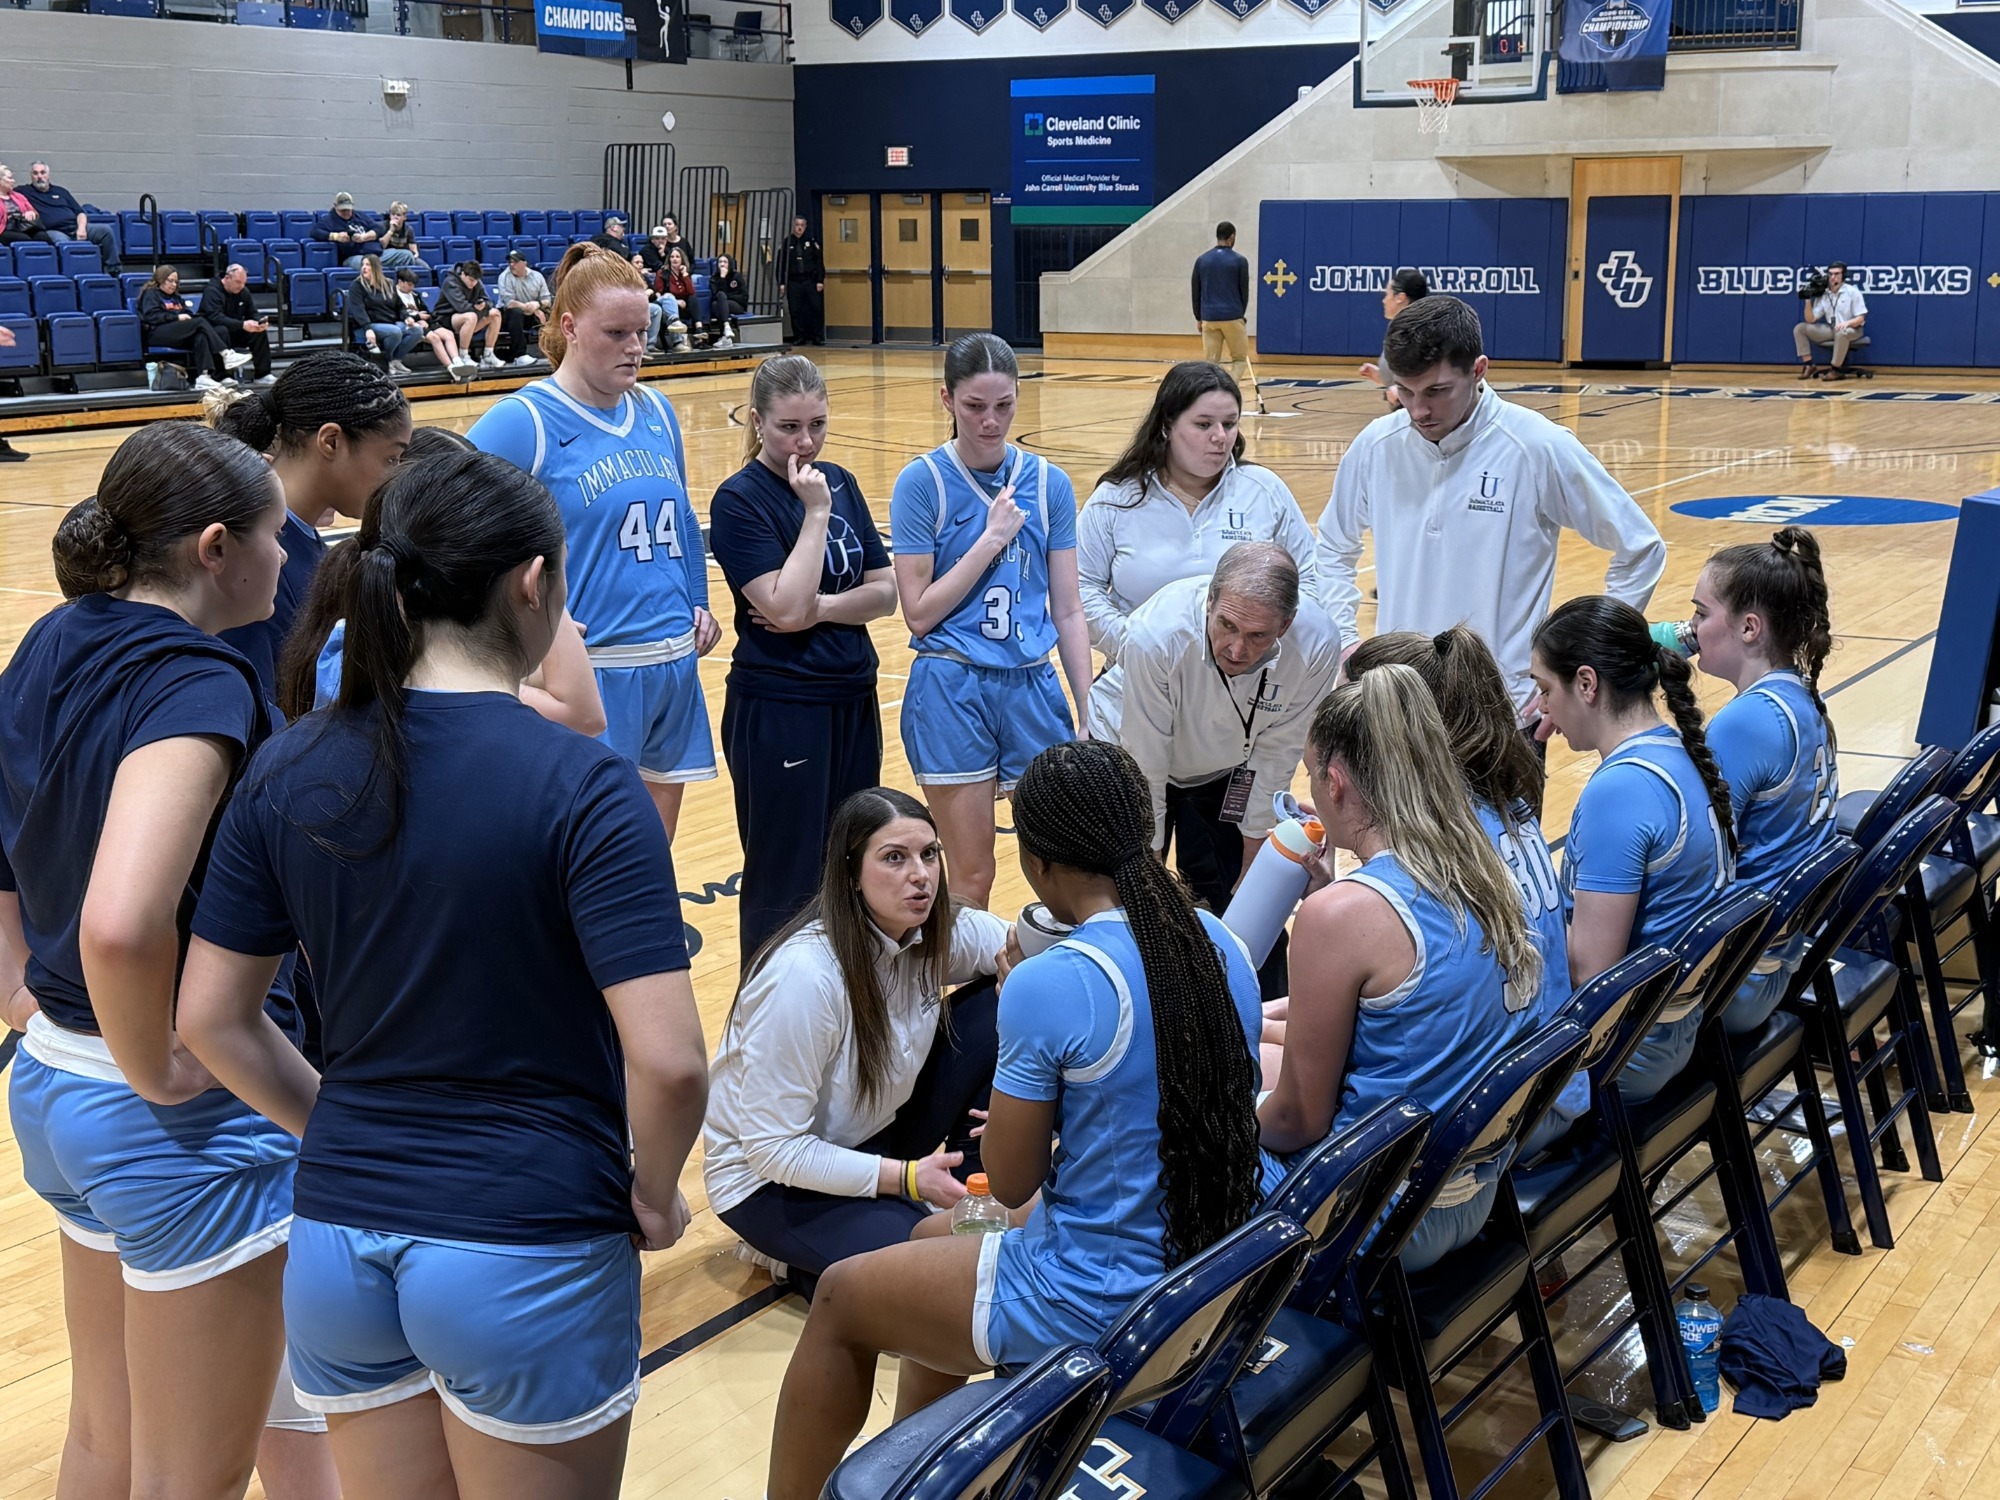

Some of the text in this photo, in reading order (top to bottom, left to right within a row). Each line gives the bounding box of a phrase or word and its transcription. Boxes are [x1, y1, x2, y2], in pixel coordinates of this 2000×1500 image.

[544, 5, 624, 32] CHAMPIONS
[1581, 19, 1650, 33] CHAMPIONSHIP
[1046, 115, 1141, 131] Cleveland Clinic
[1047, 135, 1112, 147] Sports Medicine
[1041, 174, 1062, 182] Official
[1086, 173, 1110, 181] Provider
[1111, 173, 1120, 181] for
[1024, 183, 1140, 193] John Carroll University Blue Streaks
[1309, 265, 1540, 294] JOHN ARROLL
[1697, 265, 1794, 295] BLUE
[617, 497, 683, 565] 44
[1498, 820, 1560, 921] 30
[1679, 1320, 1720, 1334] POWER
